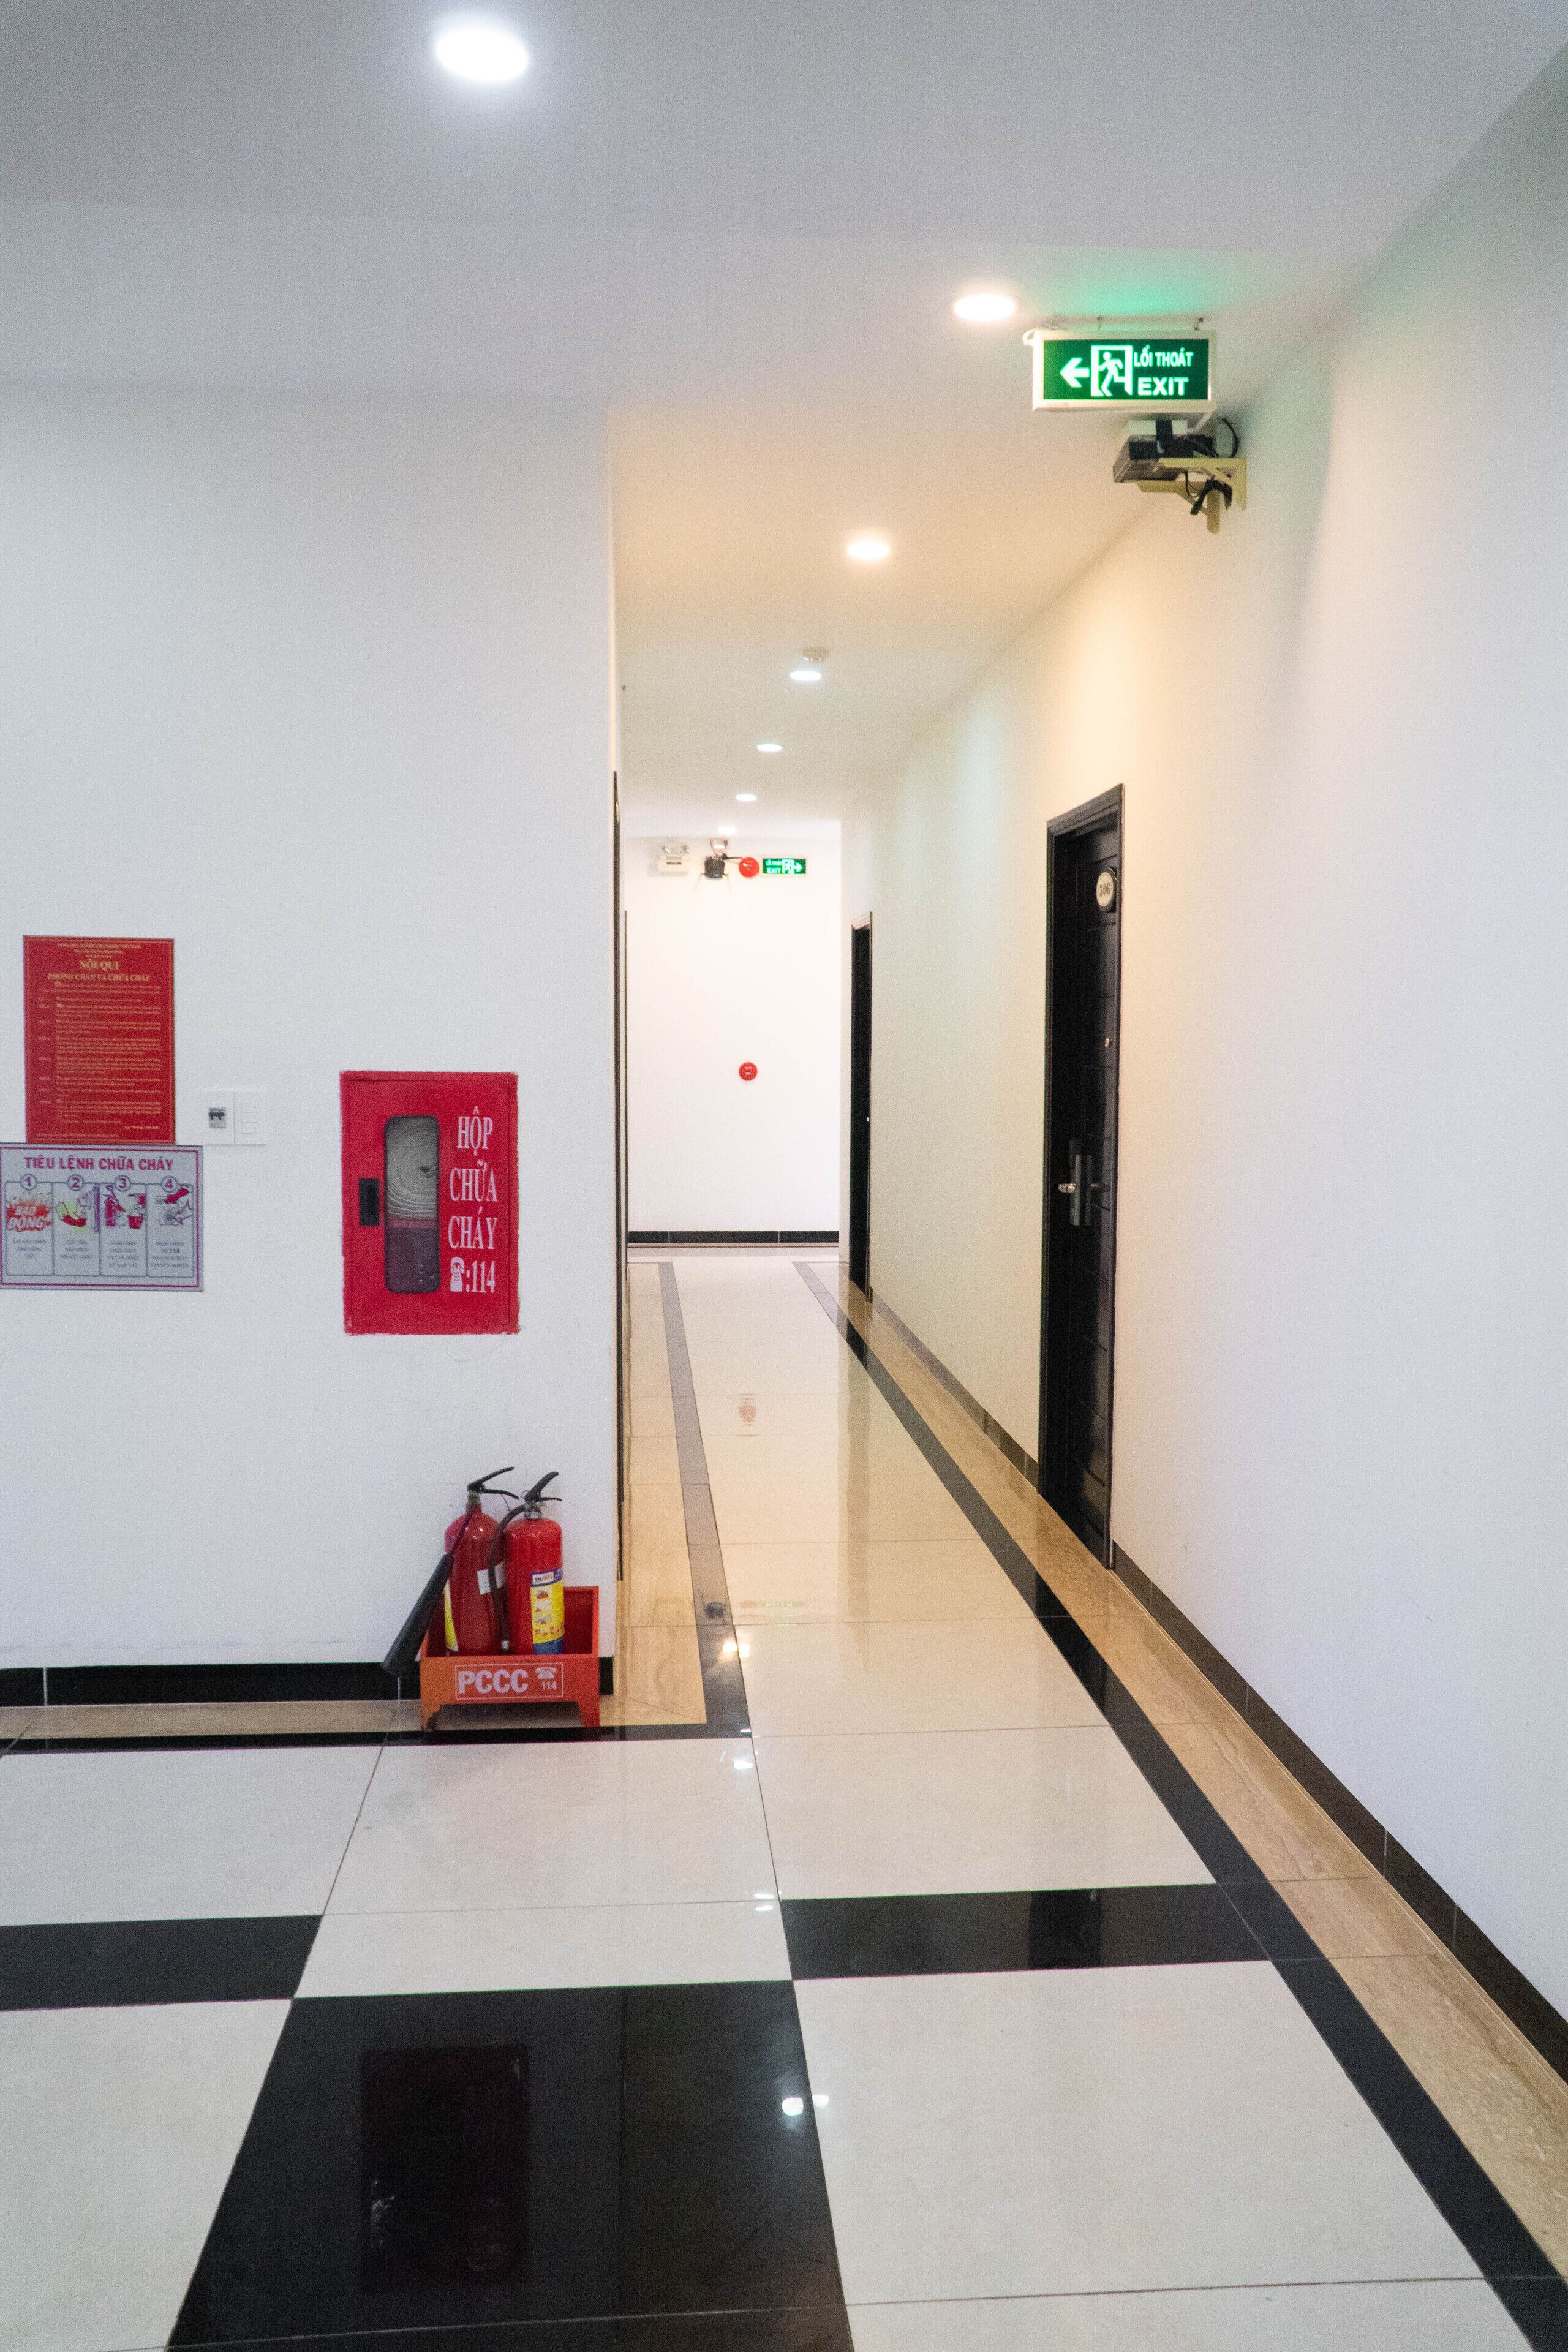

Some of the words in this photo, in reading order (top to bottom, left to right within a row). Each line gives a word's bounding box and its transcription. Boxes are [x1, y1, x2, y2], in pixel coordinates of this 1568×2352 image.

[1133, 344, 1153, 368] LỐI
[1155, 347, 1194, 368] THOÁT
[1137, 377, 1189, 396] EXIT
[100, 960, 119, 971] QUI
[456, 1106, 493, 1156] HỘP
[24, 1154, 55, 1169] TIÊU
[59, 1155, 94, 1172] LỆNH
[99, 1155, 135, 1171] CHỮA
[138, 1156, 174, 1172] CHÁY
[25, 1177, 31, 1187] 1
[71, 1177, 80, 1188] 2
[118, 1177, 127, 1189] 3
[164, 1178, 173, 1189] 4
[450, 1159, 497, 1202] CHỮA
[448, 1205, 498, 1250] CHÁY
[458, 1668, 529, 1694] PCCC
[541, 1680, 557, 1691] 114
